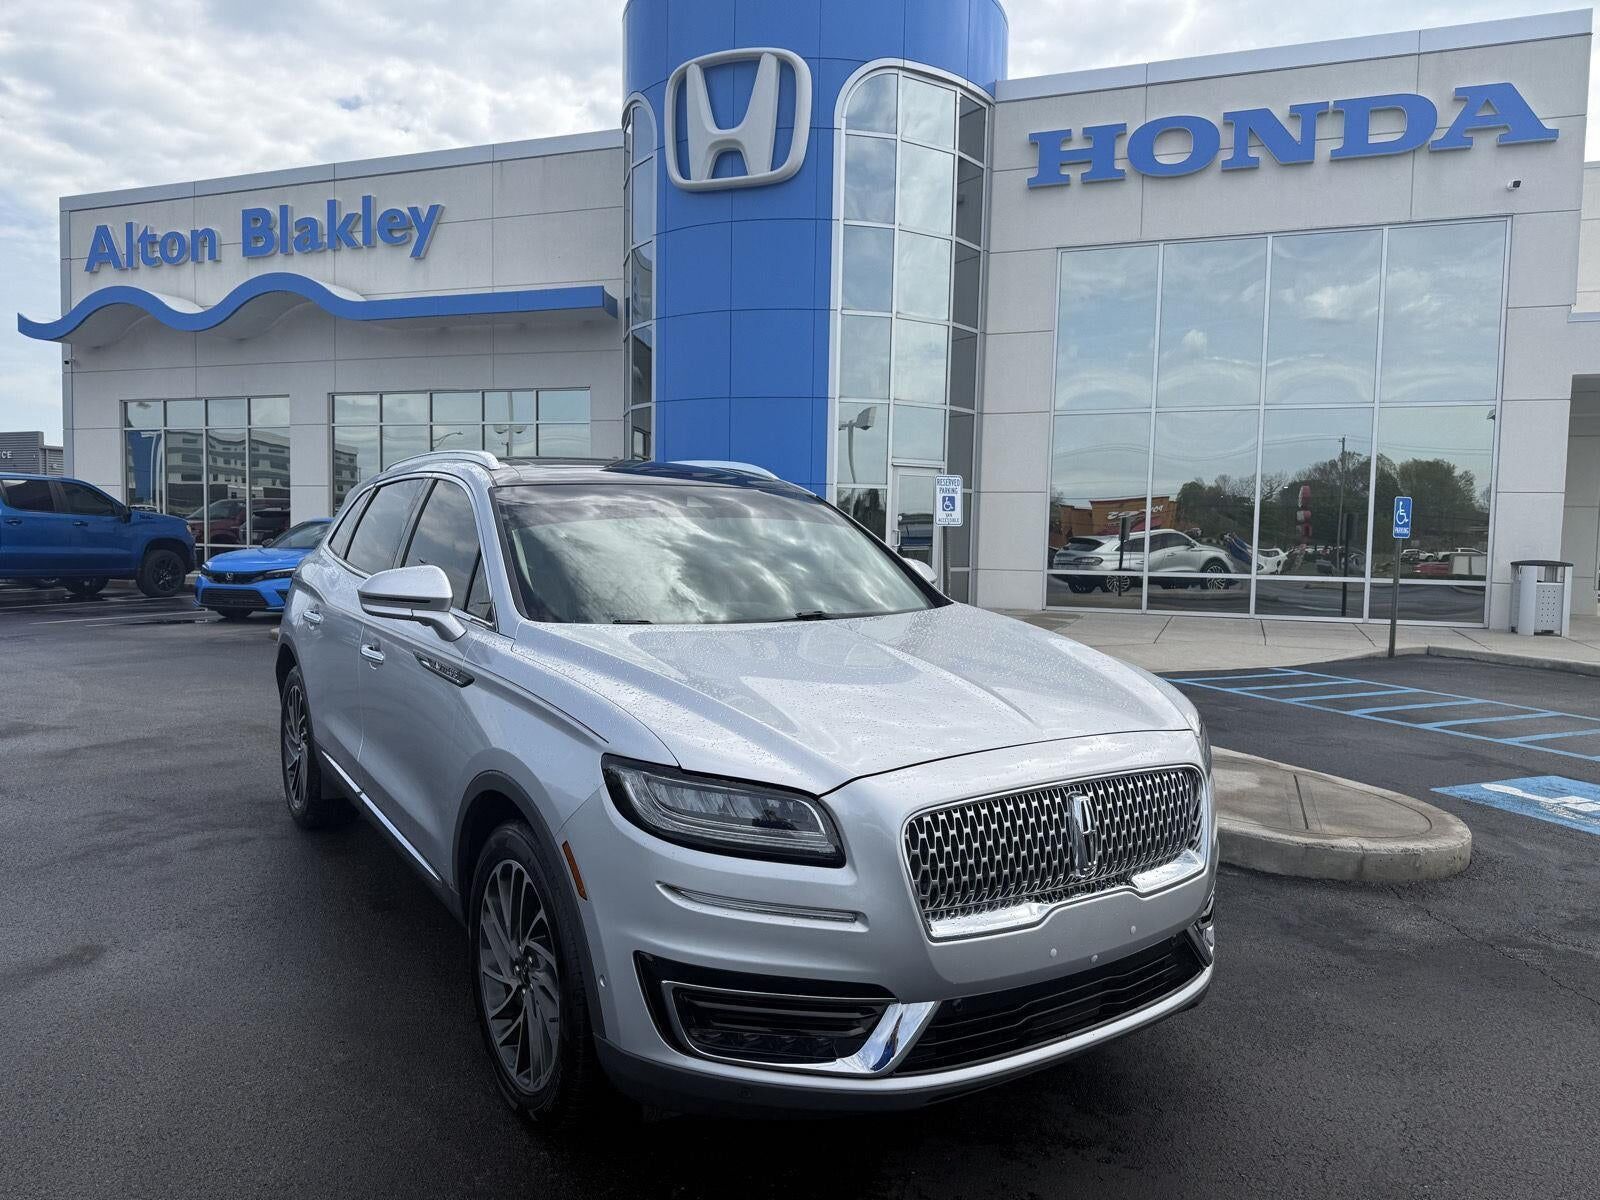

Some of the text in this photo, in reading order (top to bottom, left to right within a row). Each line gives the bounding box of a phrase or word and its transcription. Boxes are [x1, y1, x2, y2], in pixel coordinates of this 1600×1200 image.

[1027, 82, 1560, 189] HONDA
[84, 194, 446, 274] Alton Blakley
[0, 450, 12, 459] CE
